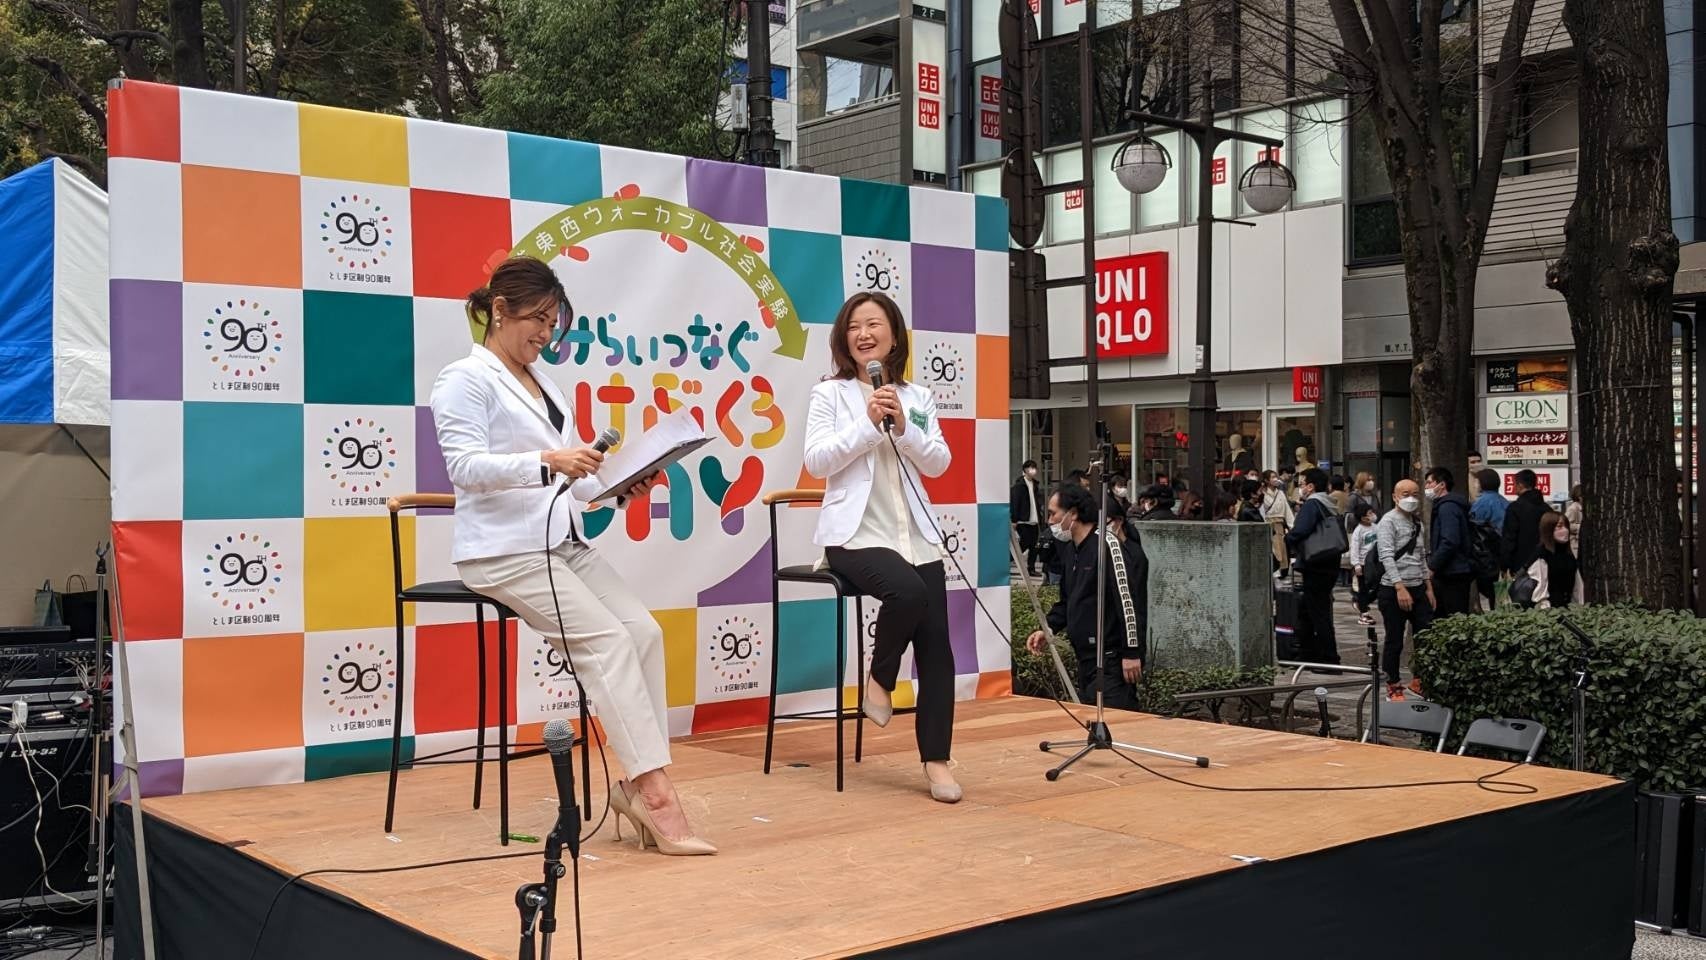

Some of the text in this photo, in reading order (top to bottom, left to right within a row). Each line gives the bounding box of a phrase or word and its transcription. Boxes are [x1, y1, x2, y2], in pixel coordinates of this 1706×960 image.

[921, 103, 937, 114] UNI
[920, 115, 938, 126] QLO
[517, 203, 789, 321] 東西ウォーカブル社会実験
[1095, 266, 1146, 305] UNI
[1096, 307, 1152, 350] QLO
[1302, 371, 1318, 385] UNI
[1302, 386, 1319, 400] QLO
[1489, 433, 1567, 444] しゃぶしゃぶバイキング
[330, 497, 390, 506] としま区制90周
[581, 456, 765, 541] AY
